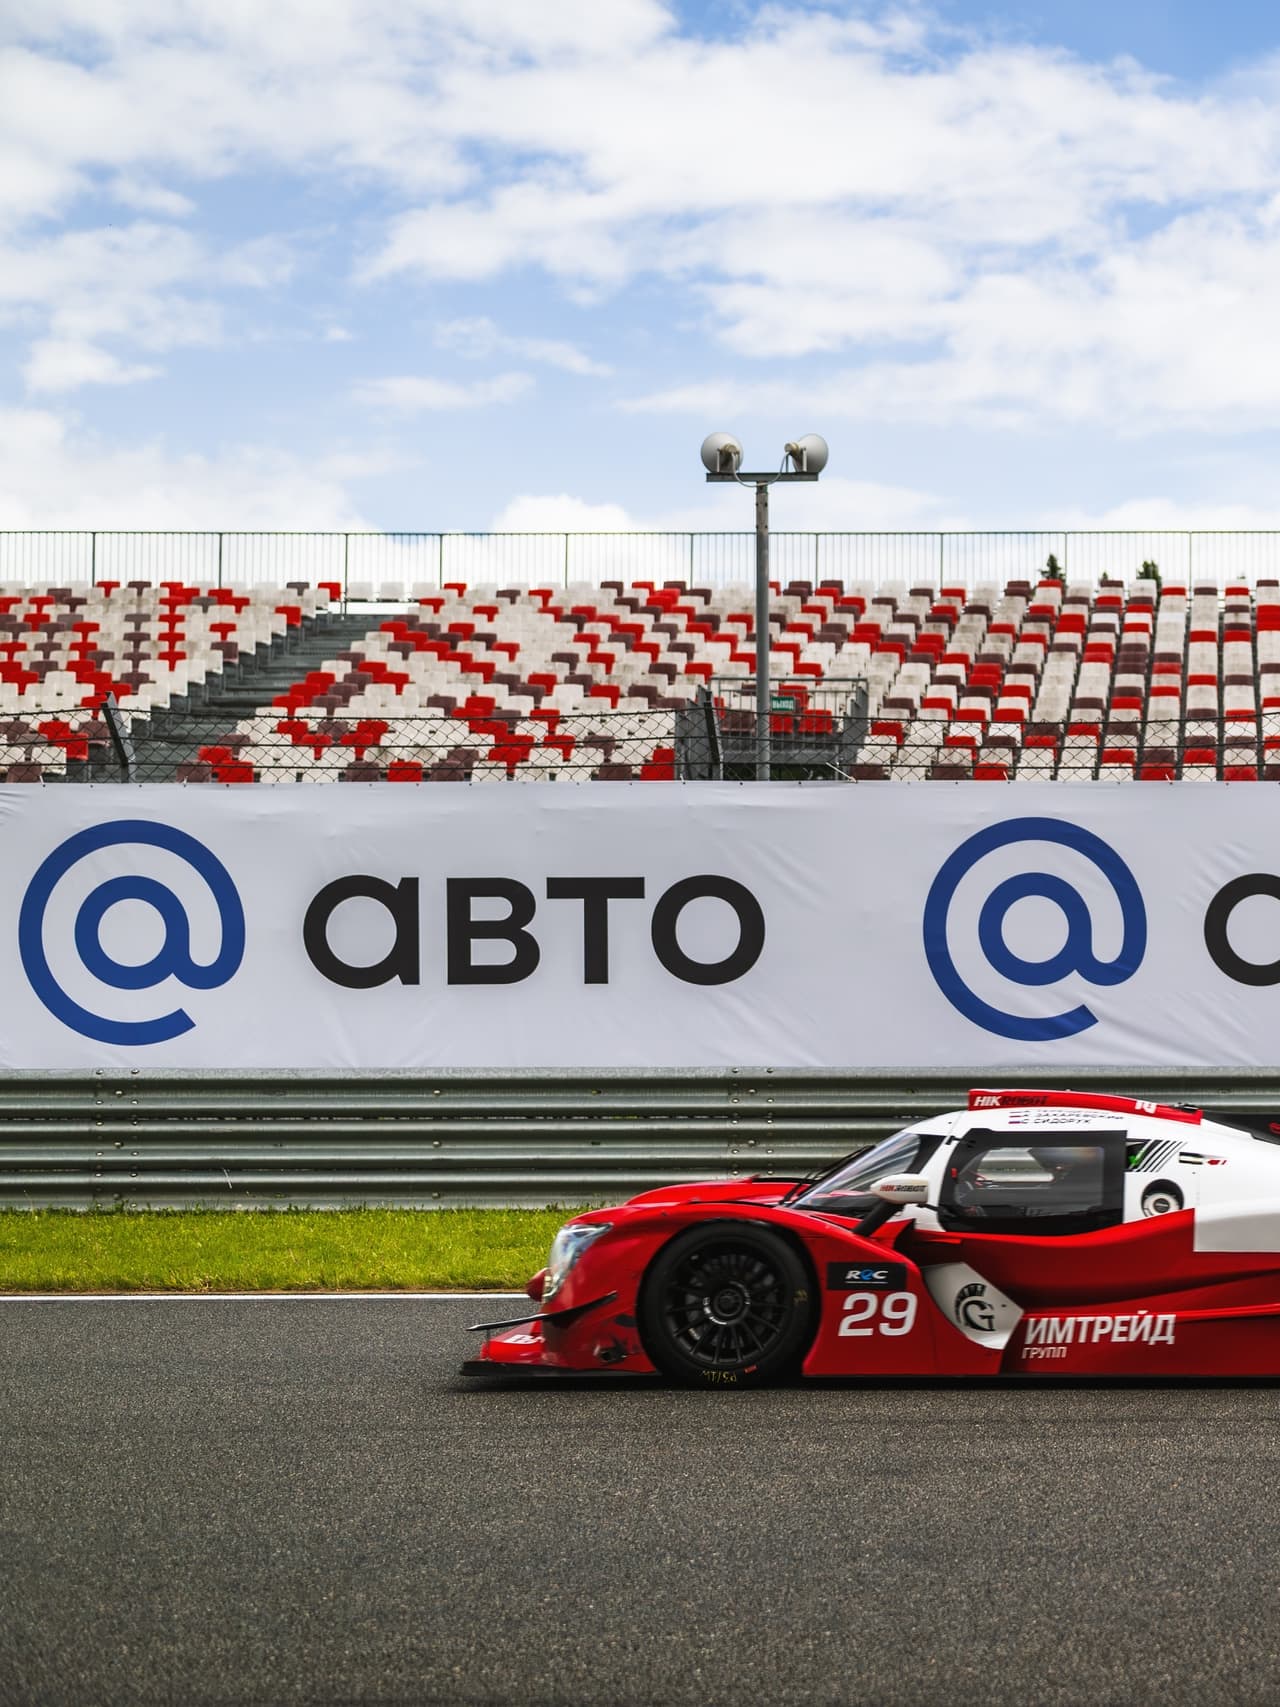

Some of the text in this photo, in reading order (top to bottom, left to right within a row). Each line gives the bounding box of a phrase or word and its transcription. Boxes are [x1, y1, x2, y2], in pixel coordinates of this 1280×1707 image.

[838, 1291, 918, 1337] 29
[1024, 1310, 1177, 1345] ИМТРЕЙД
[1021, 1346, 1067, 1359] ГРУПП
